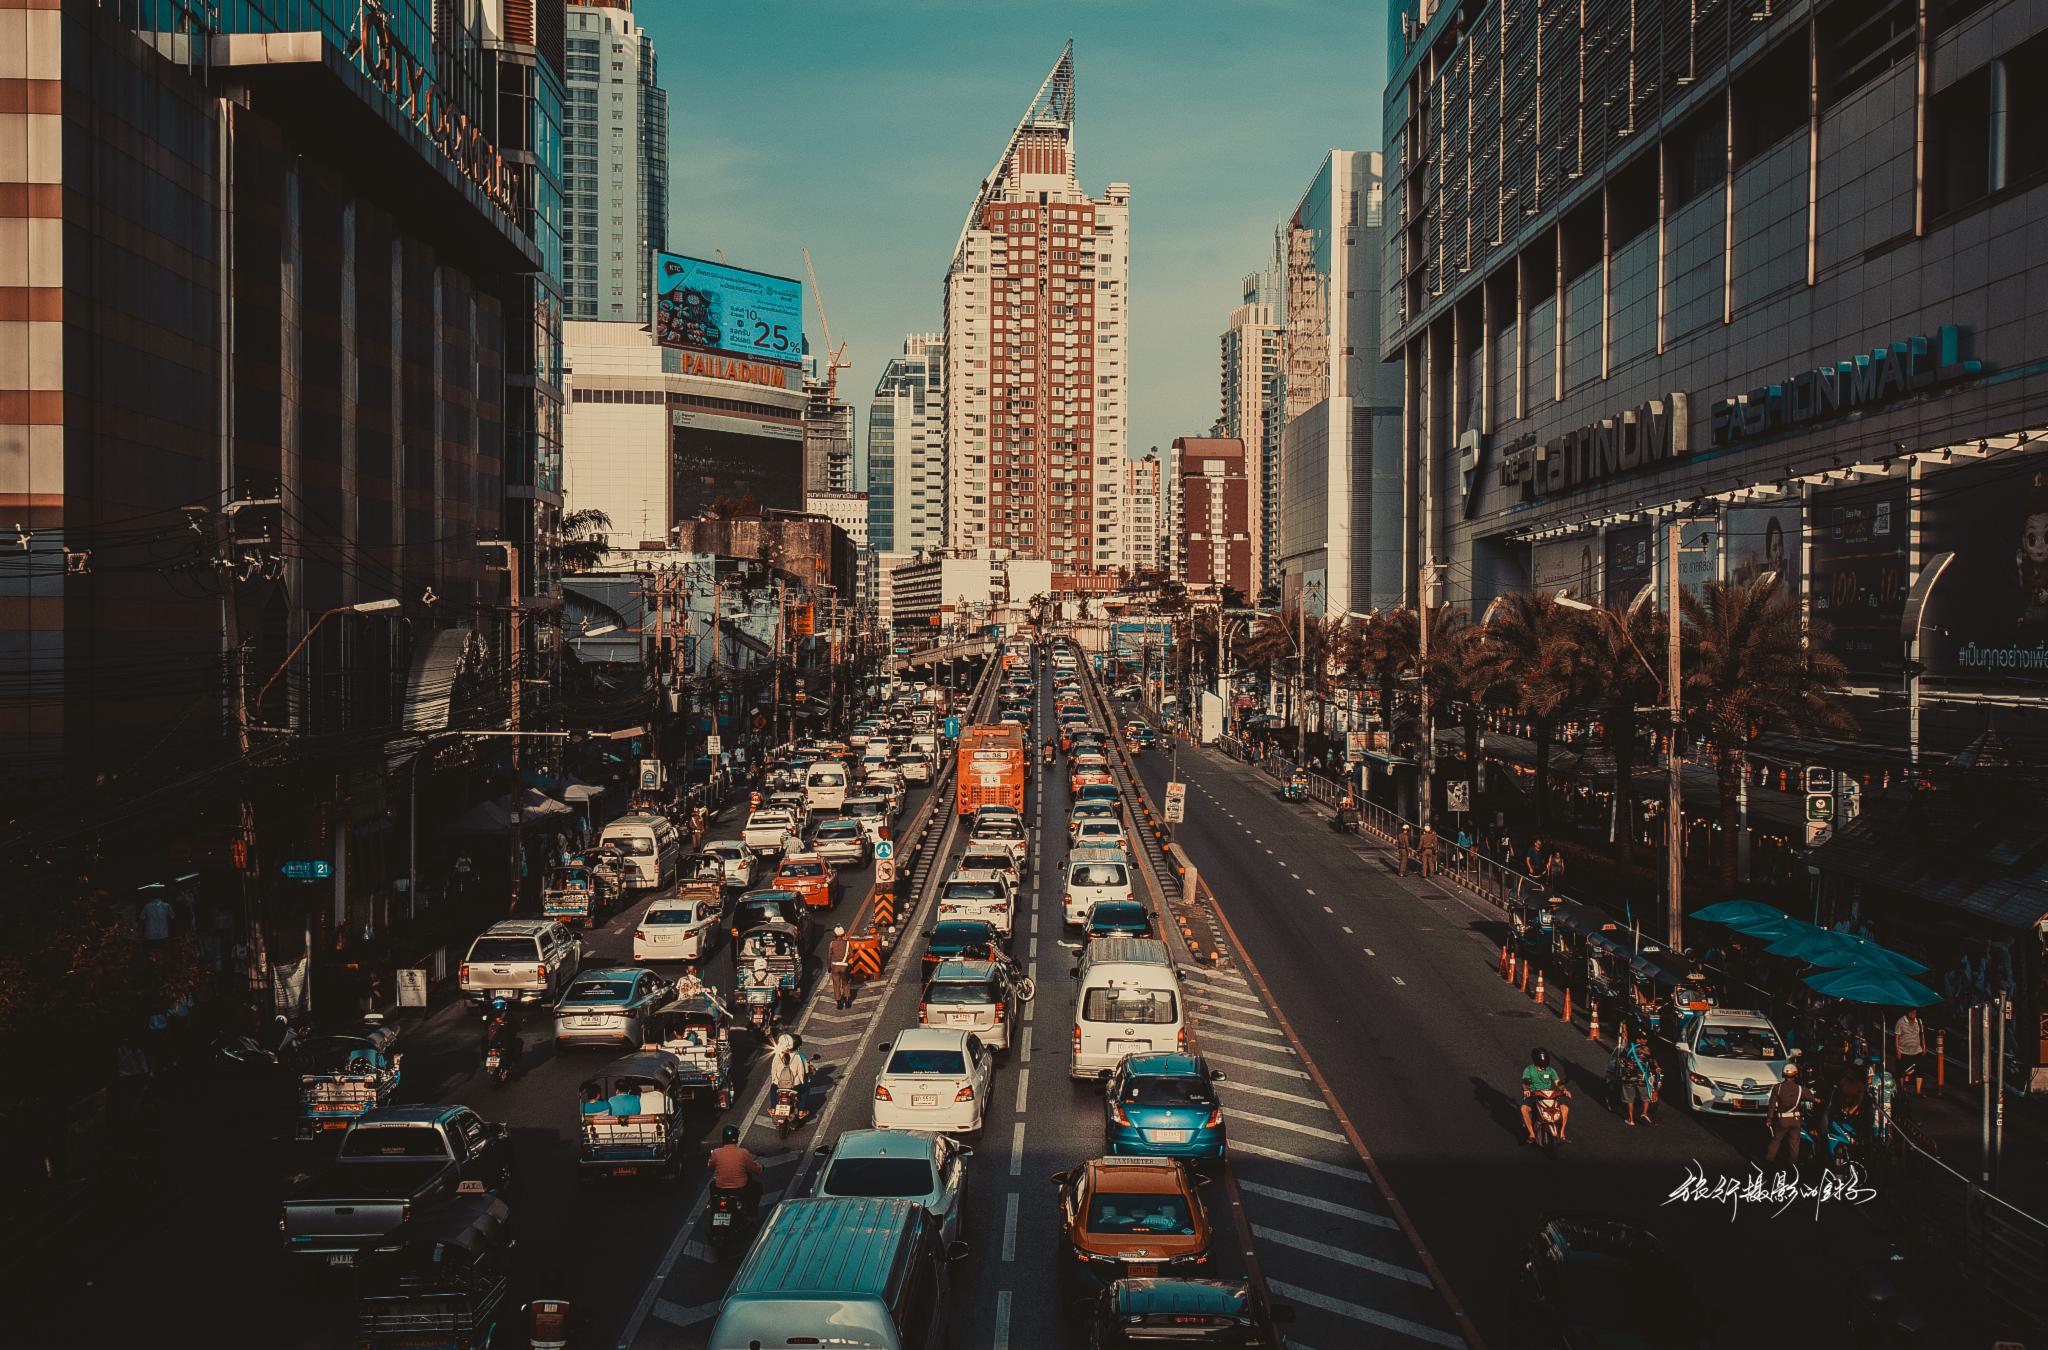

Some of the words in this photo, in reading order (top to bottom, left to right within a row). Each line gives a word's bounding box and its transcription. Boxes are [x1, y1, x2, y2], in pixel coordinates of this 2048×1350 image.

[668, 264, 682, 272] KTC
[682, 351, 786, 389] PALLADIUM
[1711, 360, 1852, 446] FASHION
[1852, 323, 1983, 408] MALL
[317, 863, 328, 874] 21
